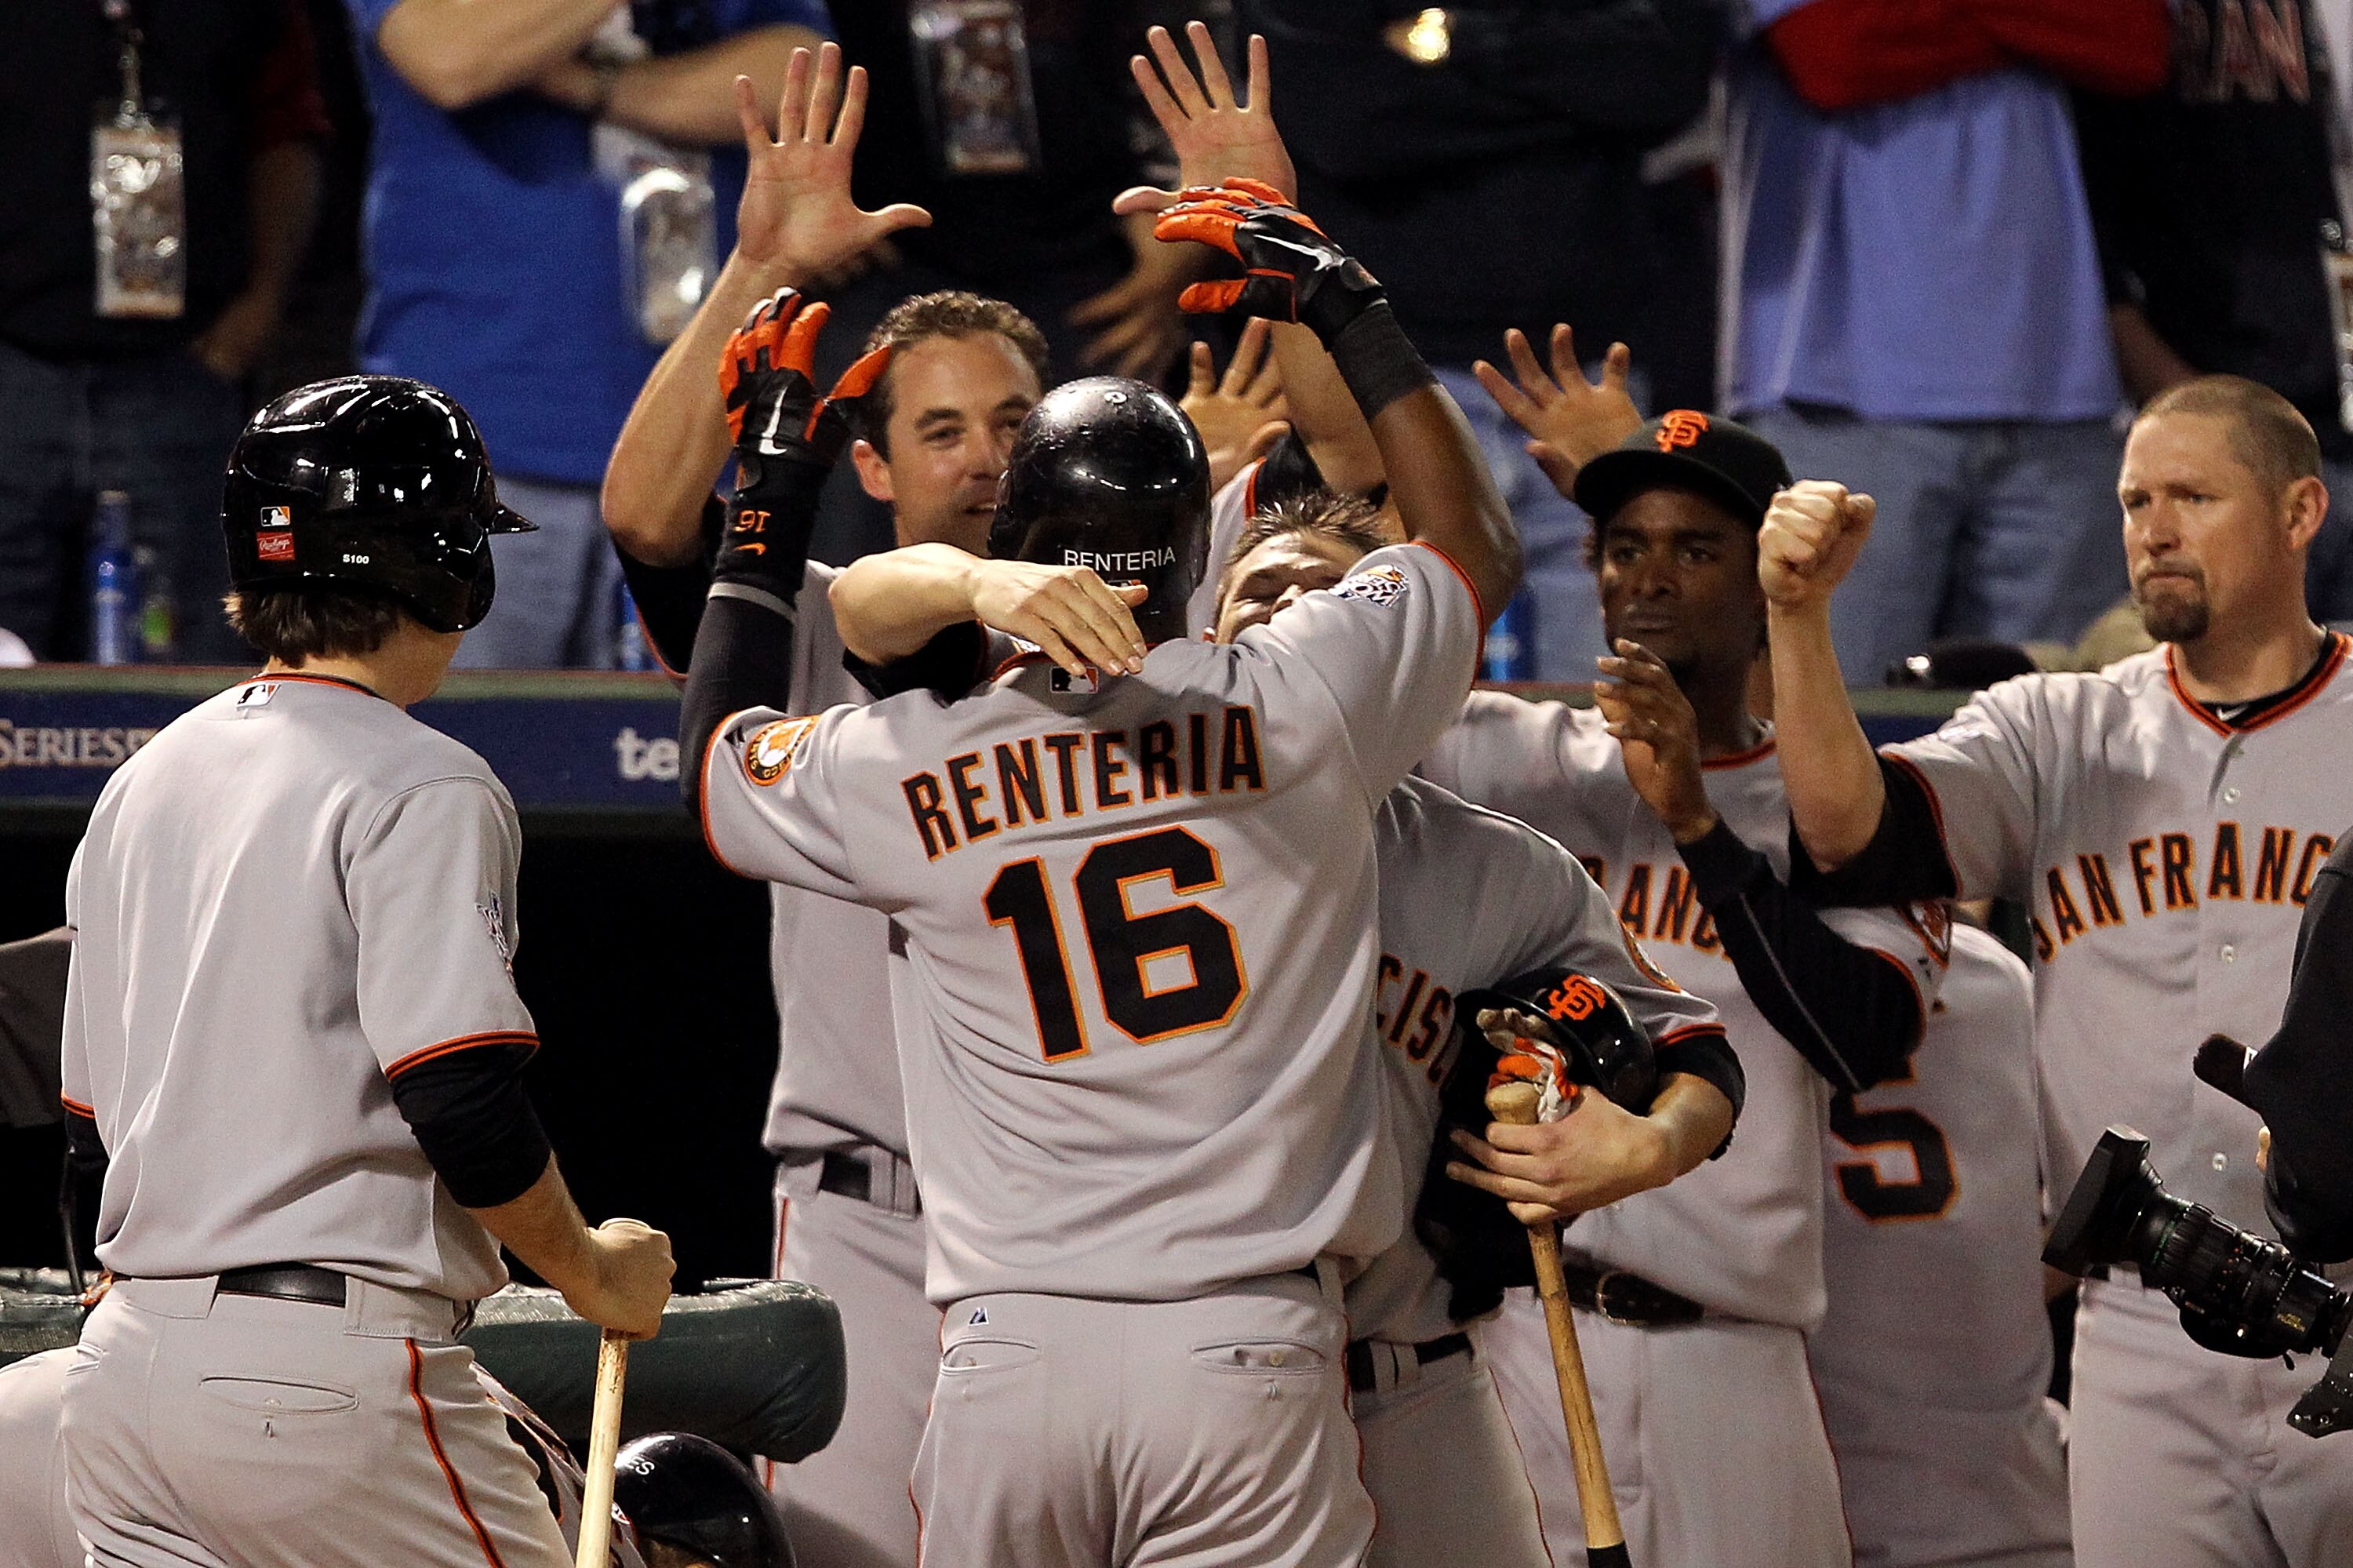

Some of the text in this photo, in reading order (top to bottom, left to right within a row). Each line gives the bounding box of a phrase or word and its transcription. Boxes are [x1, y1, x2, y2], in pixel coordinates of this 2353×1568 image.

[1656, 409, 1709, 453] SF
[342, 554, 369, 564] S100
[1064, 546, 1176, 571] RENTERIA
[900, 705, 1266, 861] RENTERIA
[2128, 820, 2333, 918] FRANC
[980, 824, 1250, 1063] 16
[1549, 974, 1606, 1020] SF
